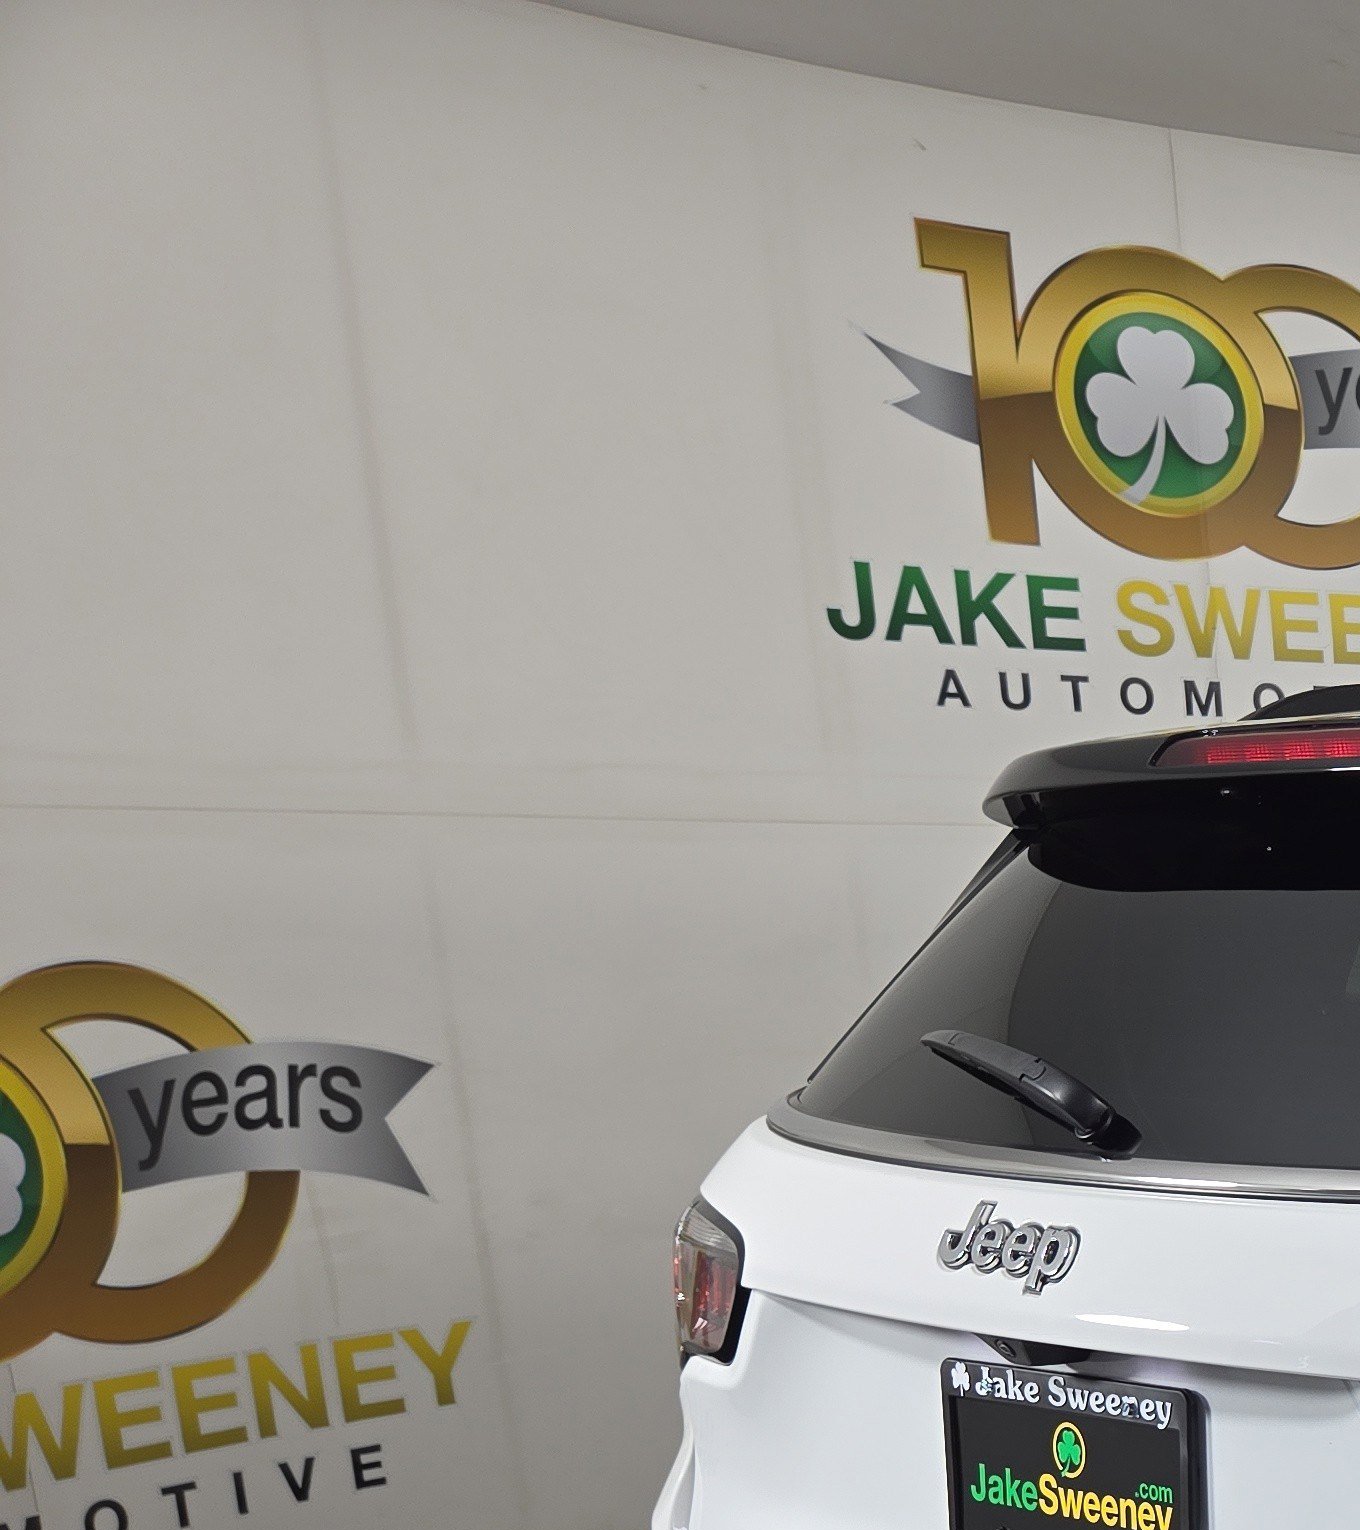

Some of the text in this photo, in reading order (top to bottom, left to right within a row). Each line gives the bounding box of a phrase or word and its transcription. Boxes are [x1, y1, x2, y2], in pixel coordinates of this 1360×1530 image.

[826, 560, 1087, 651] JAKE
[936, 668, 1290, 718] AUTOMO
[127, 1062, 364, 1171] years
[938, 1199, 1082, 1296] Jeep
[975, 1365, 1172, 1430] Jake Sweeney
